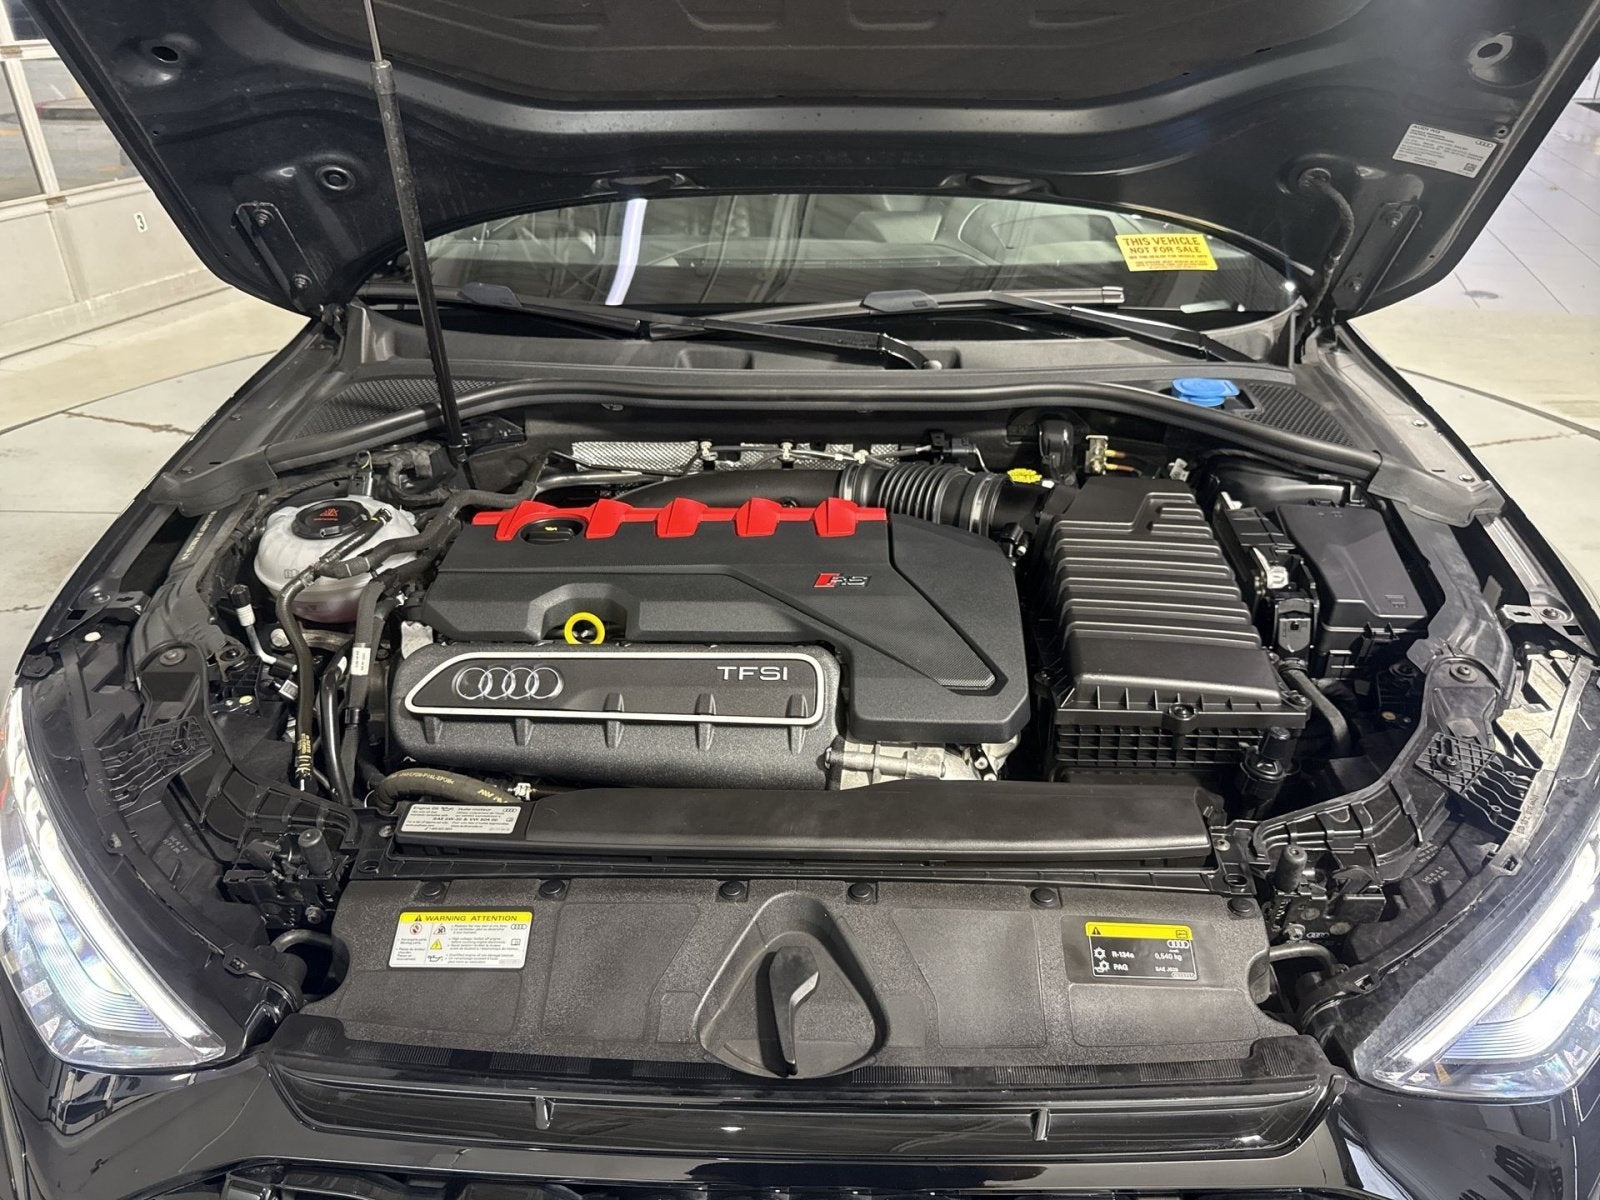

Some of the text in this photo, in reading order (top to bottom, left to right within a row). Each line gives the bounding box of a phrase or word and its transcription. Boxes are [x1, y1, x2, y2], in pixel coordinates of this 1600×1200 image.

[136, 214, 145, 230] 3
[1122, 236, 1201, 246] THIS VEHICLE
[820, 573, 869, 588] RS
[716, 666, 788, 681] TFSI
[1111, 950, 1135, 959] R-134a
[1173, 953, 1183, 962] kg
[1113, 963, 1129, 971] PAG
